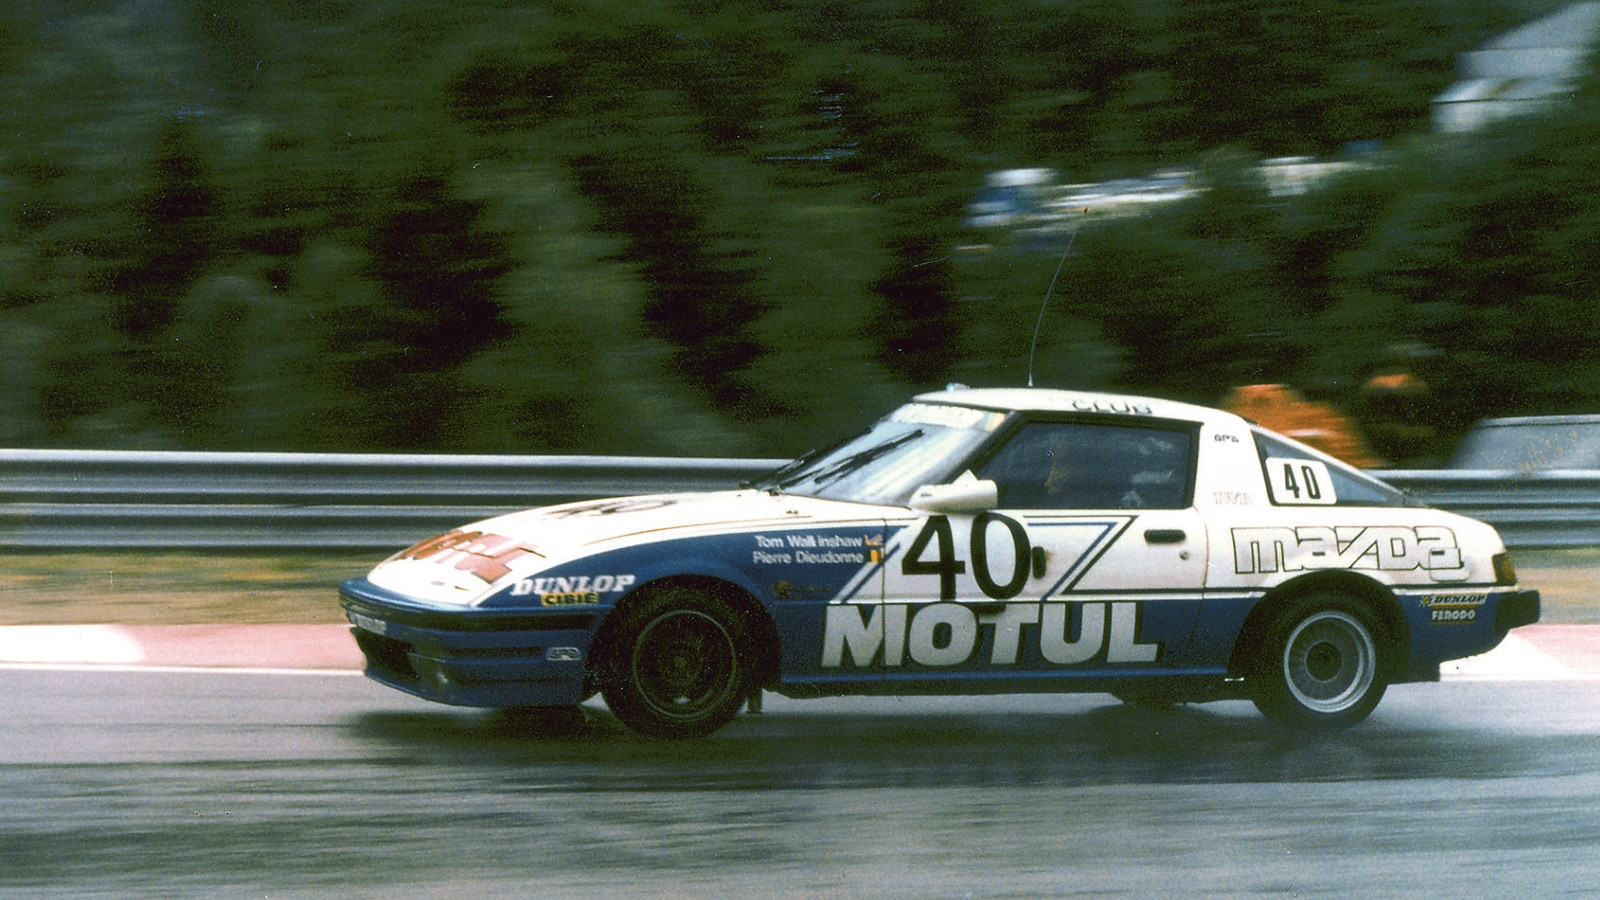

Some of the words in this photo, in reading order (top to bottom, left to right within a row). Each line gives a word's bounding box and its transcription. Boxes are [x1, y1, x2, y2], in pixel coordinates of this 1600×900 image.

[1284, 463, 1321, 500] 40
[754, 535, 784, 548] Tom
[752, 550, 792, 564] Pierre
[901, 511, 1031, 600] 40
[509, 574, 636, 596] DUNLOP
[544, 592, 597, 606] CIBIE
[822, 602, 1158, 668] MOTUL
